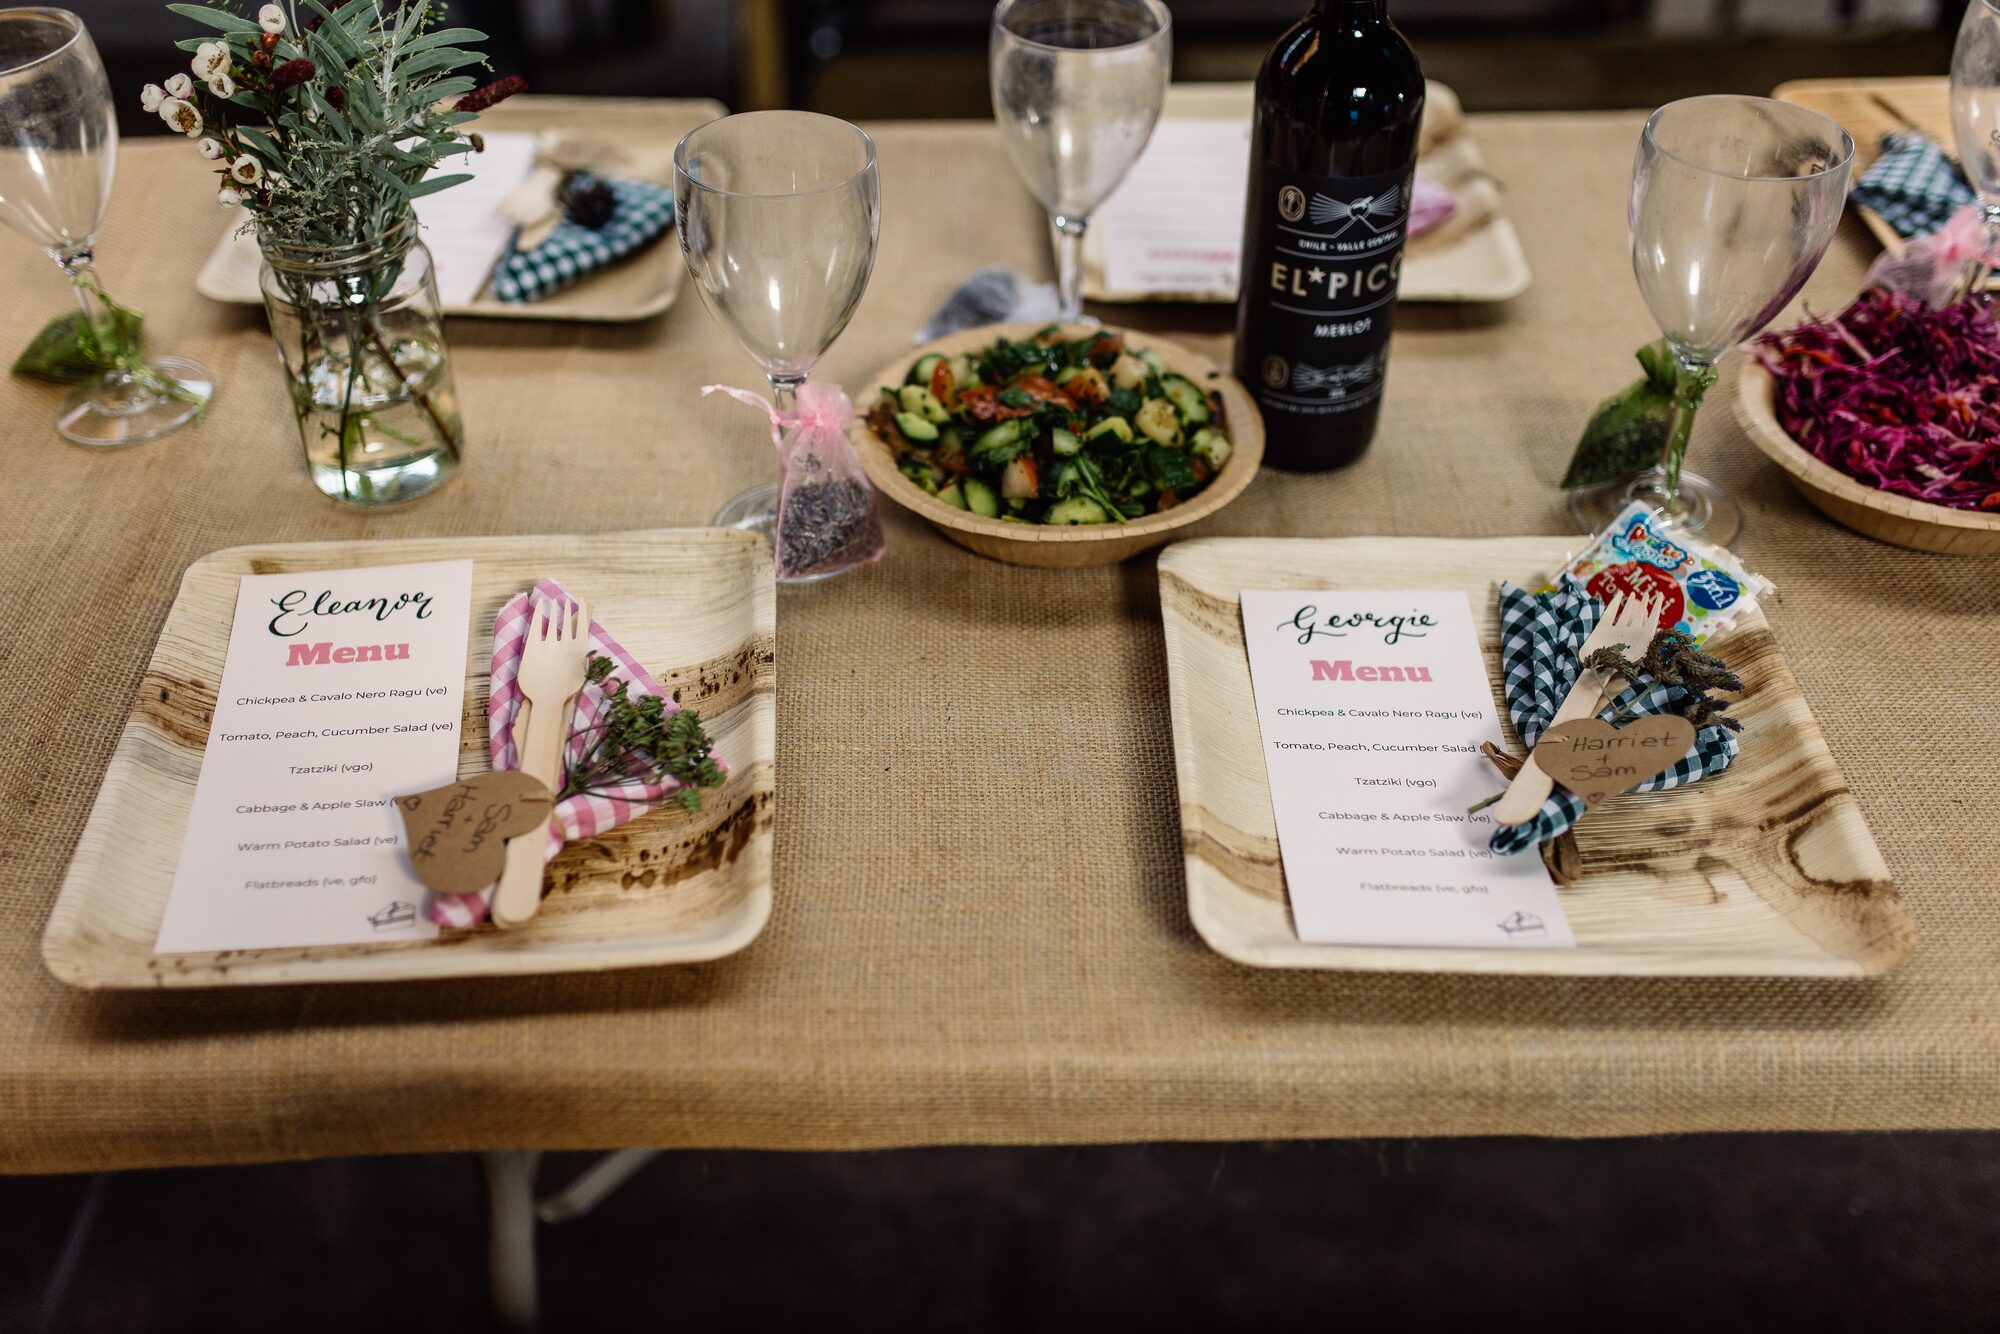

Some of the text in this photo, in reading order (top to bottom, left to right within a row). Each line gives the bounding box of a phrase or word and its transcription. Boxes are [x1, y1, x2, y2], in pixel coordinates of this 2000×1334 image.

[1298, 239, 1327, 252] CHILE
[1336, 240, 1366, 252] VALLE
[1270, 261, 1308, 297] EL
[1313, 317, 1373, 337] MERLOT
[269, 590, 433, 637] Eleanor
[1277, 605, 1437, 645] Georgie
[286, 642, 410, 667] Menu
[1309, 660, 1433, 682] Menu
[236, 686, 448, 706] Chickpea & Cavalo Nero Ragu (ve)
[1276, 707, 1483, 720] Chickpea & Cavalo Nero Ragu (ve)
[219, 721, 454, 742] Tomato, Peach, Cucumber Salad (ve)
[1272, 741, 1326, 752] Tomato,
[1327, 742, 1370, 752] Peach,
[1372, 743, 1439, 753] Cucumber
[1441, 744, 1477, 753] Salad
[1571, 731, 1678, 753] Harriet
[289, 761, 374, 775] Tzatziki (vgo)
[1568, 763, 1637, 782] Sam
[1353, 777, 1437, 789] Tzatziki (vgo)
[235, 803, 299, 816] Cabbage
[299, 802, 310, 811] &
[311, 800, 353, 812] Apple
[354, 799, 388, 809] Slaw
[413, 784, 480, 859] Harriet
[1318, 811, 1491, 825] Cabbage & Apple Slaw (ve)
[462, 803, 512, 853] Sam
[237, 834, 399, 852] Warm Potato Salad (ve)
[1335, 847, 1493, 860] Warm Potato Salad (ve)
[243, 874, 378, 891] Flatbreads (ve, gfo)
